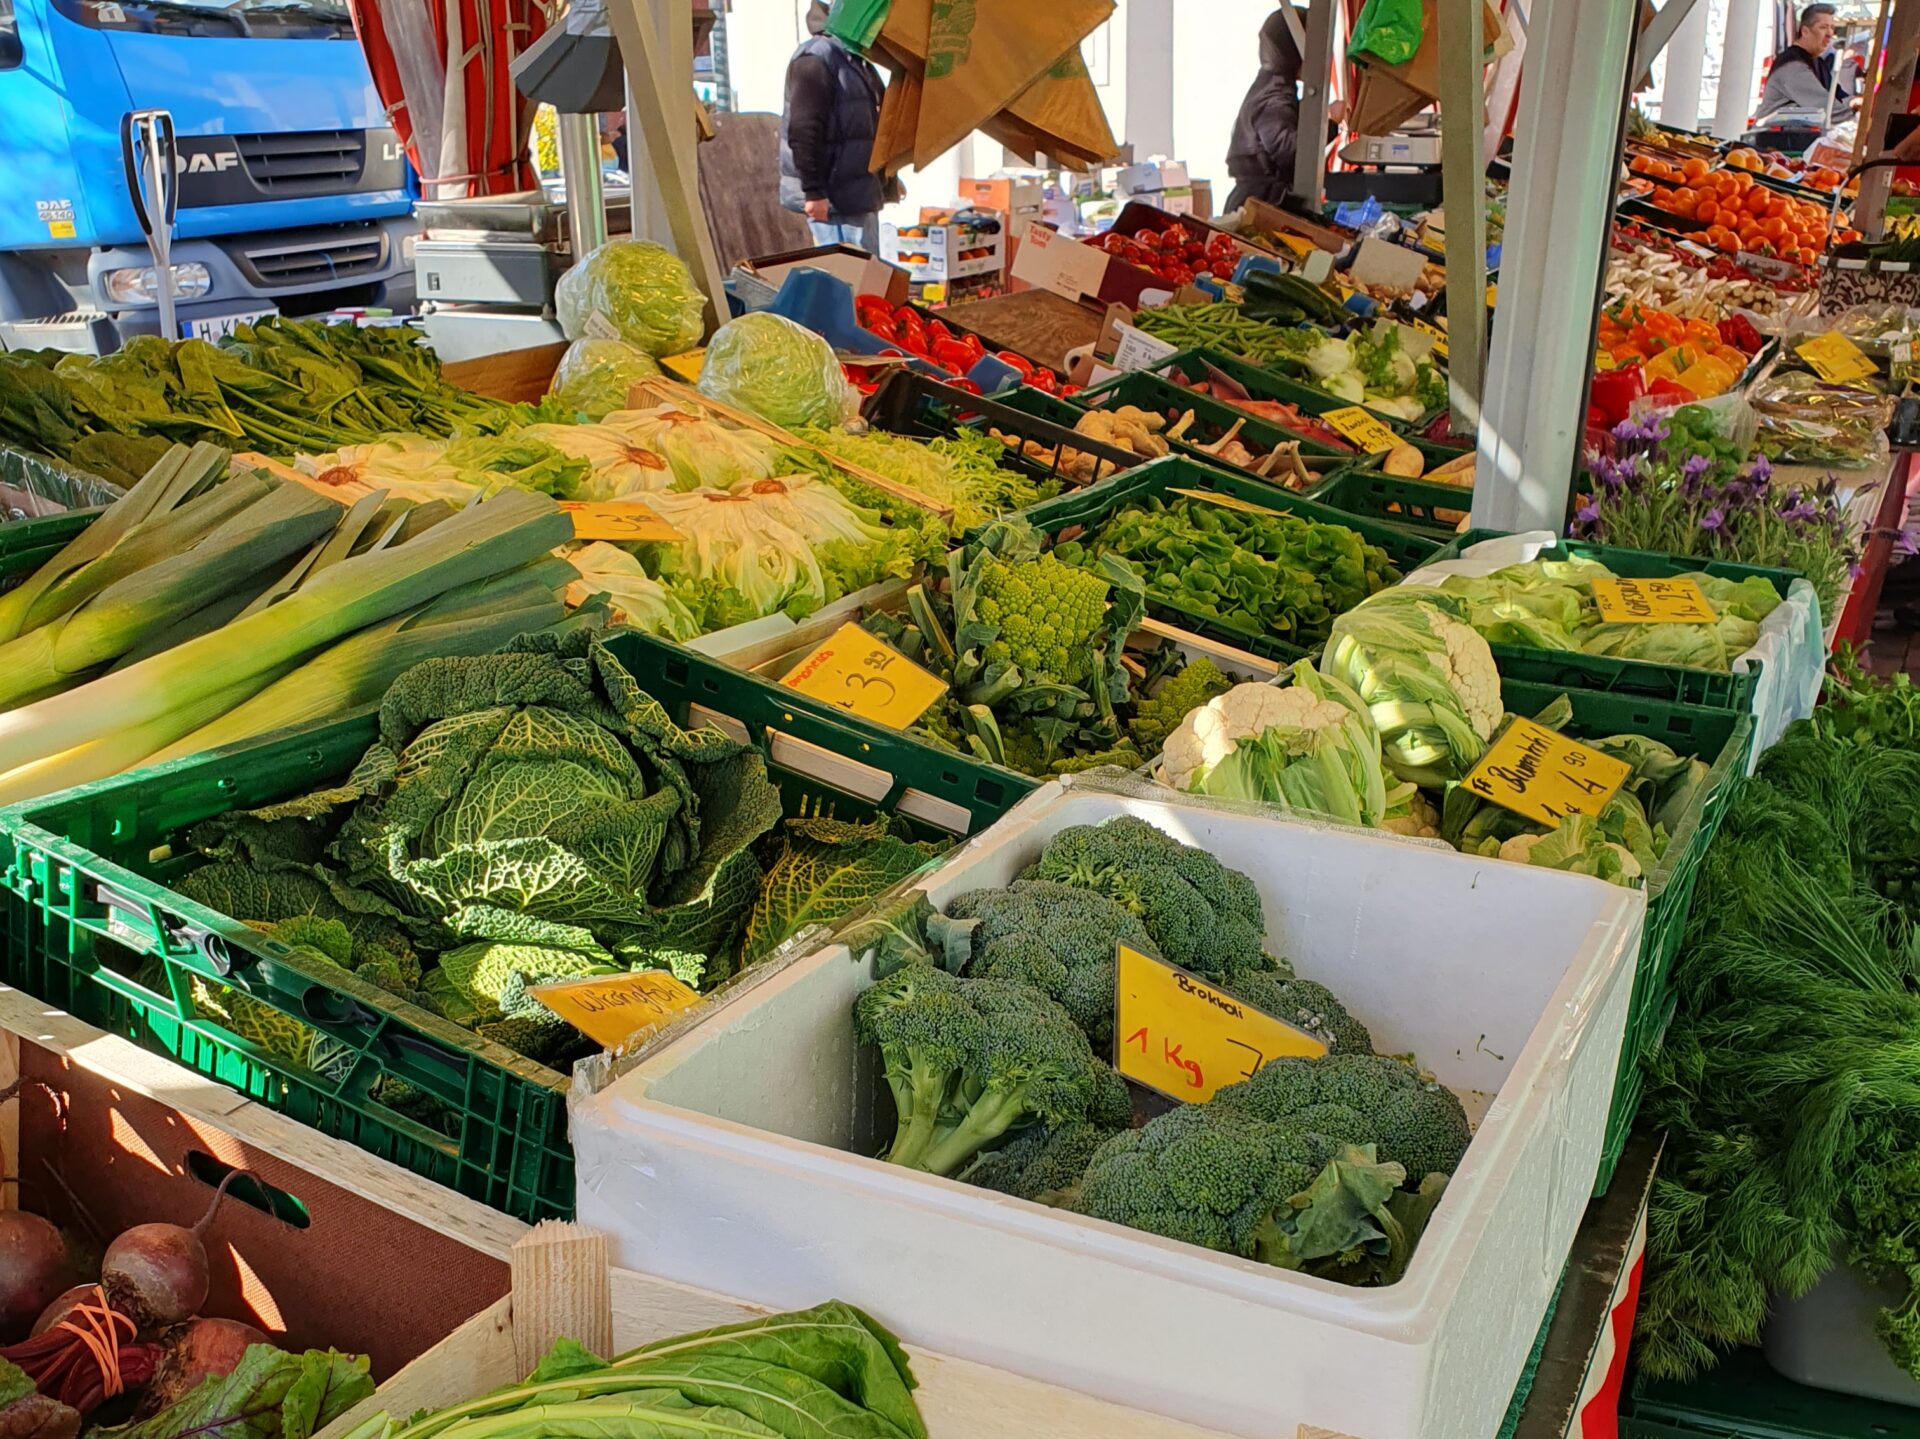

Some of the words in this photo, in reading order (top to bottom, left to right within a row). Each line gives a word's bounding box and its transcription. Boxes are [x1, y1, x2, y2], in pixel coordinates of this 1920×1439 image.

[36, 200, 72, 210] DAF
[199, 321, 213, 342] H
[845, 672, 896, 708] 3
[1562, 751, 1588, 768] 90
[1557, 770, 1608, 795] 4
[1172, 973, 1244, 1019] Brokkoli
[1126, 1027, 1148, 1053] 1
